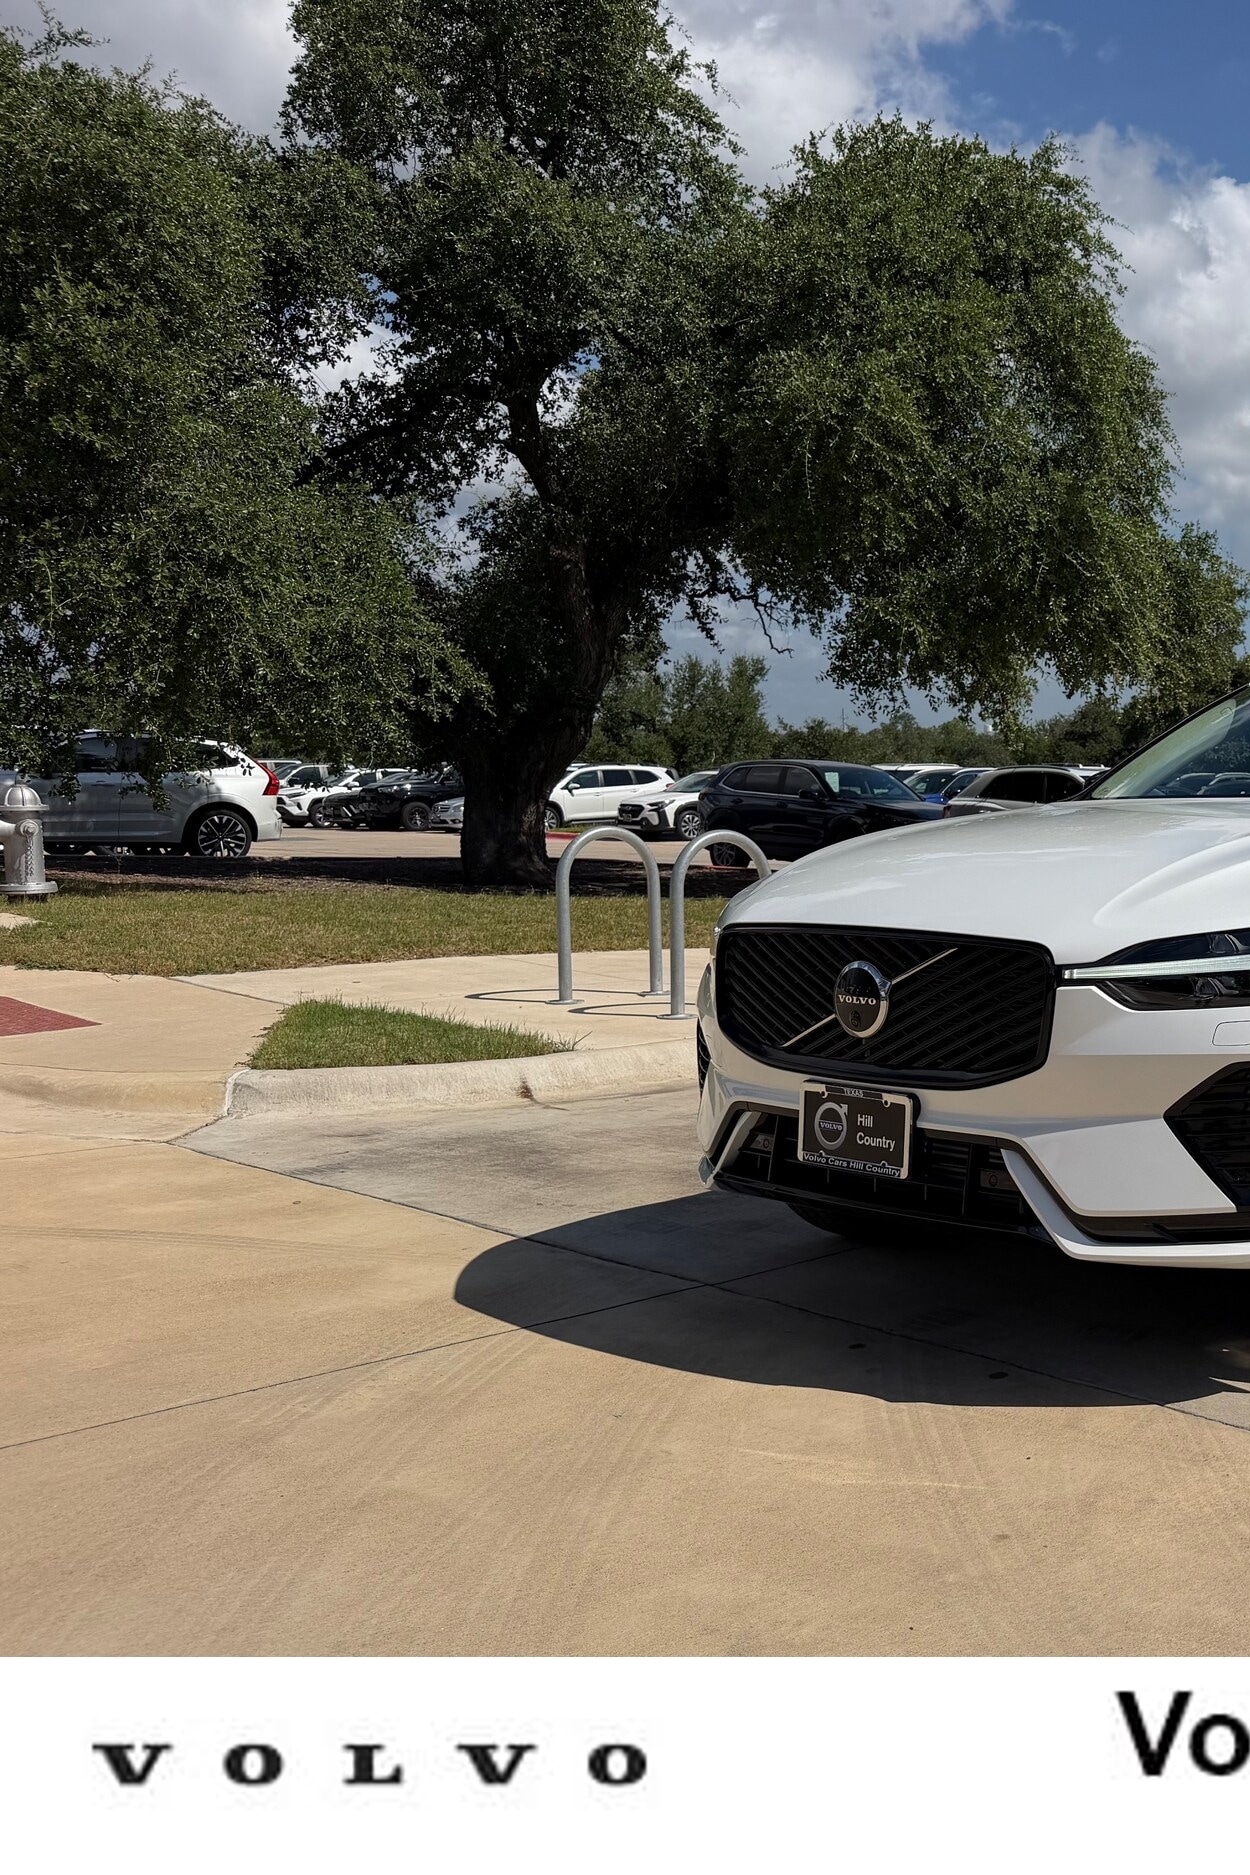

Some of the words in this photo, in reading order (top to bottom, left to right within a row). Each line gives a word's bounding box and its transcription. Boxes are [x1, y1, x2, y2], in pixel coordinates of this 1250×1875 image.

[838, 994, 877, 1006] VOLVO
[843, 1088, 864, 1098] TEXAS
[820, 1121, 843, 1131] VOLVO
[857, 1113, 873, 1128] Hill
[856, 1132, 896, 1152] Country
[803, 1153, 827, 1164] Volvo
[828, 1157, 848, 1168] Cars
[849, 1161, 864, 1170] Hill
[865, 1164, 900, 1177] Country
